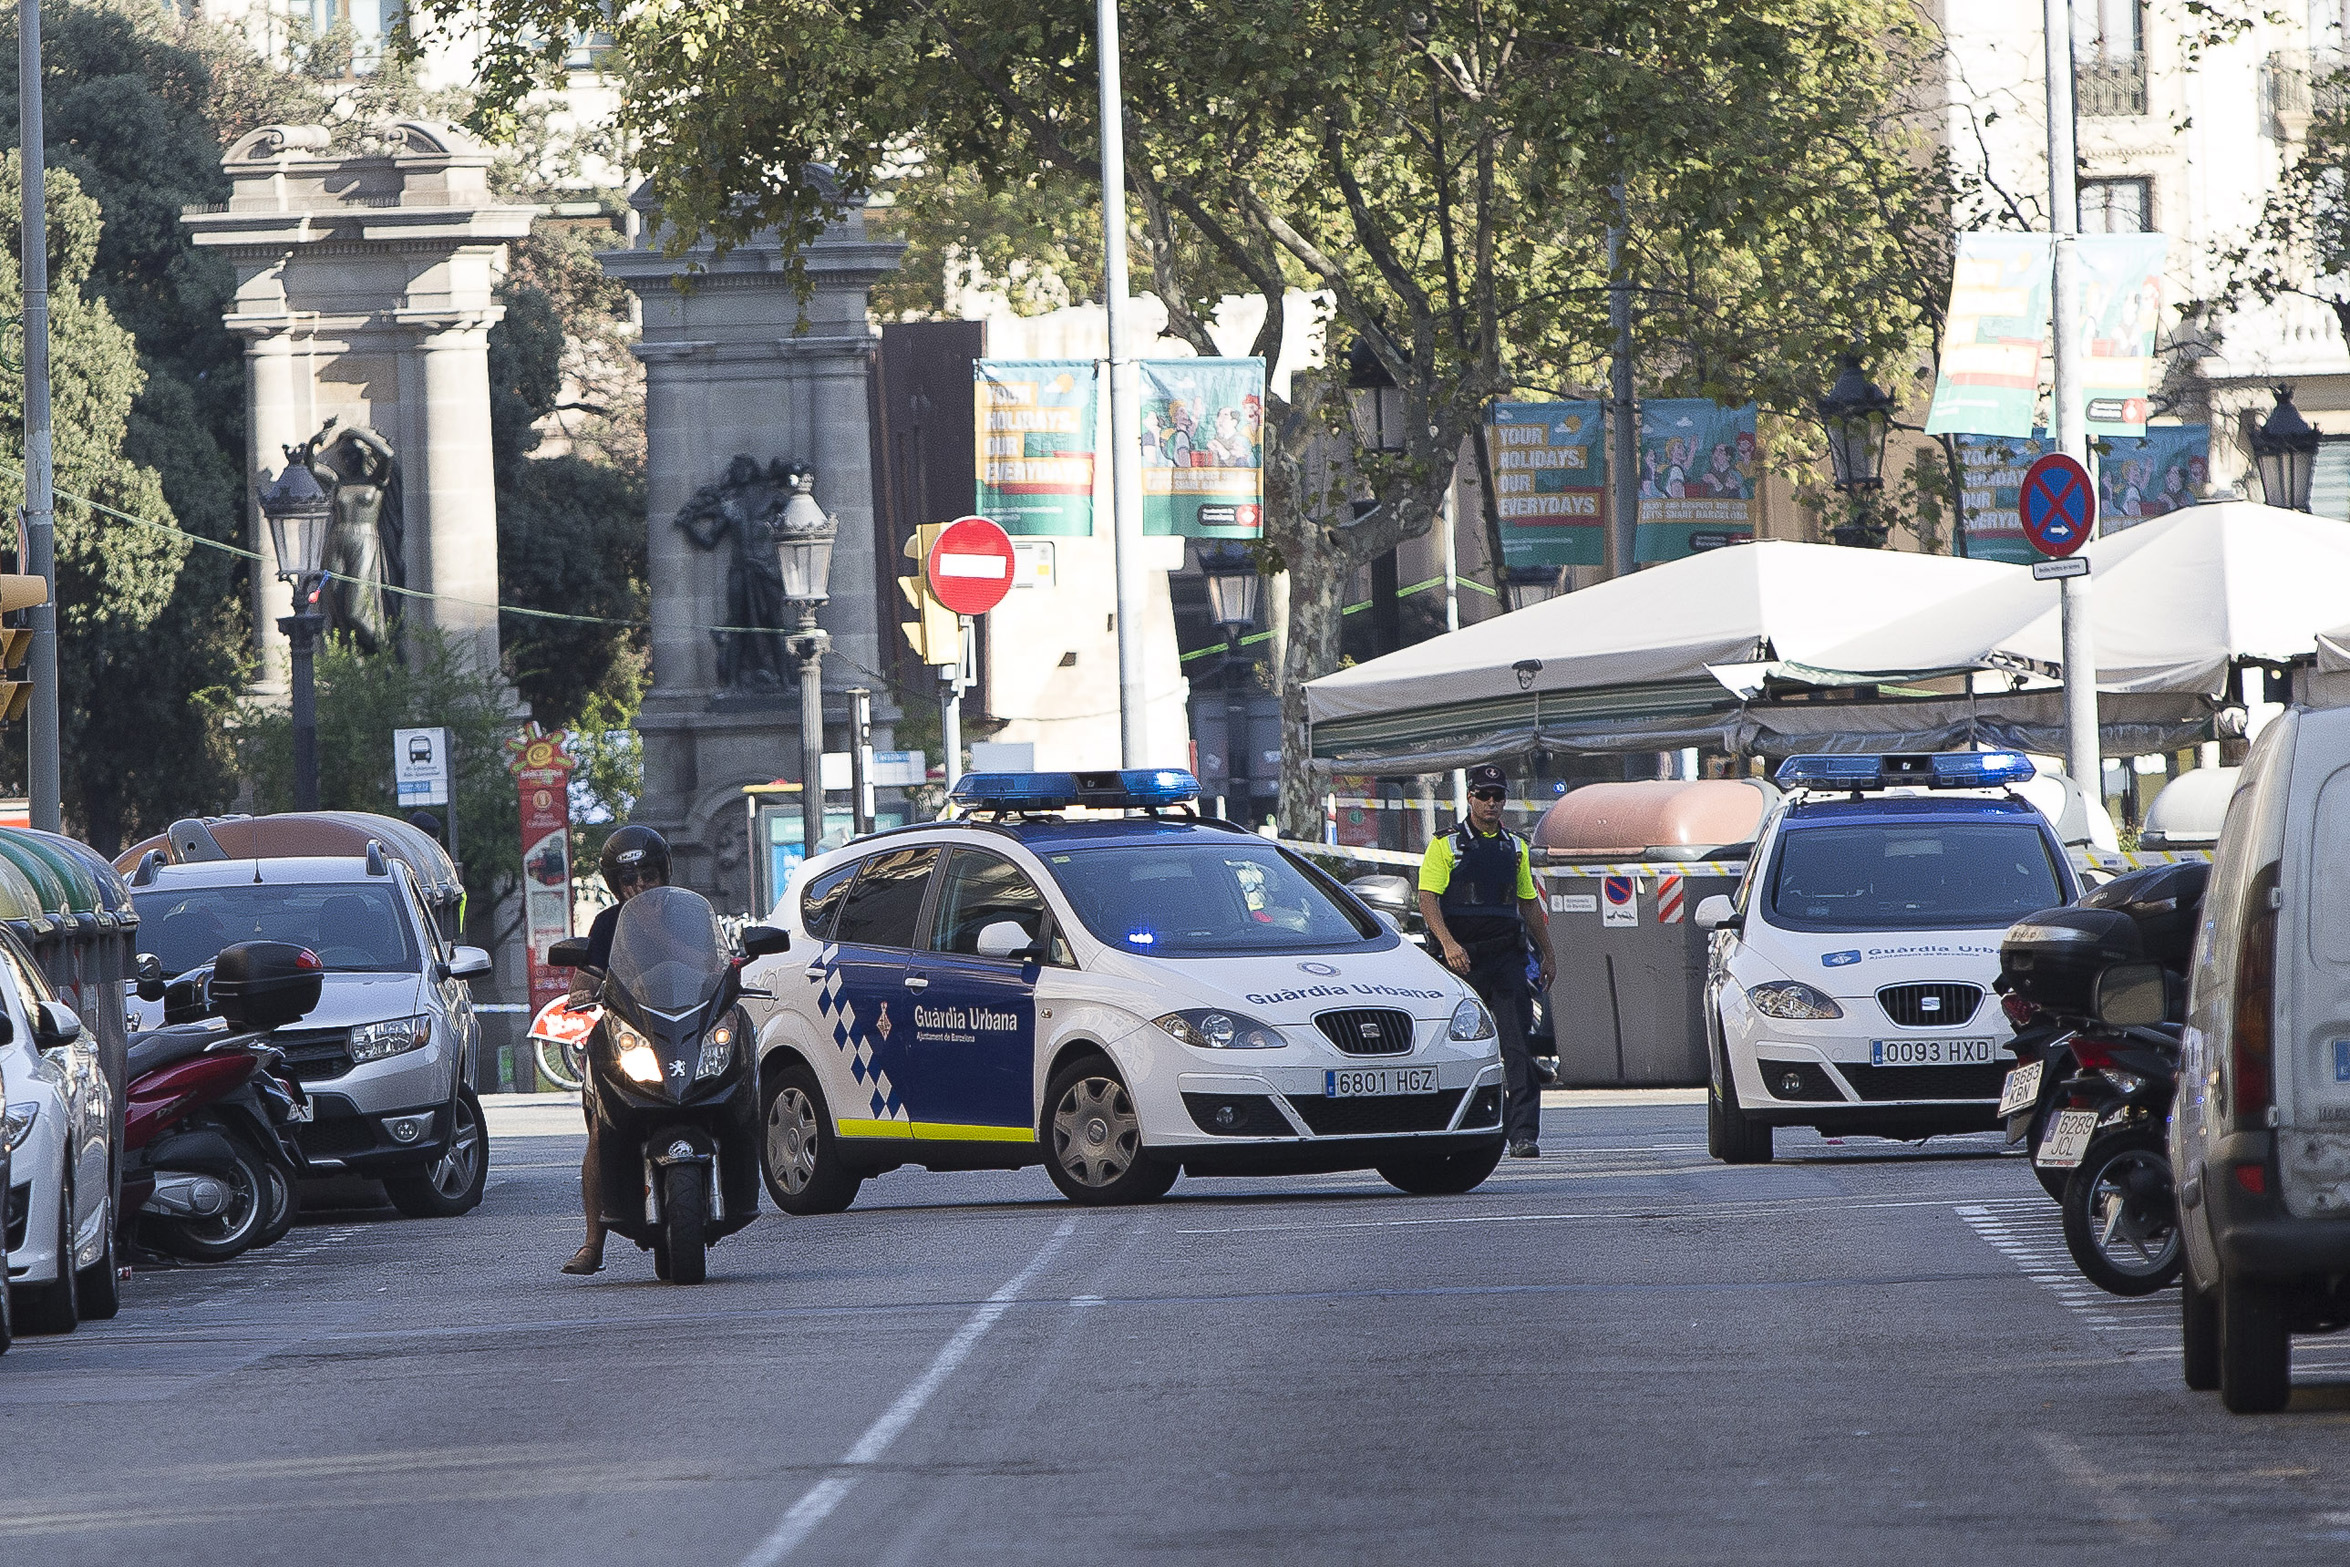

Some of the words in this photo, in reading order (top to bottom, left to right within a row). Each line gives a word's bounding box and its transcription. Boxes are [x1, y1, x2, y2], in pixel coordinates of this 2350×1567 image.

[1499, 428, 1543, 446] YOUR
[1499, 449, 1585, 469] HOLIDAYS,
[1499, 474, 1531, 494] OUR
[1499, 496, 1595, 517] EVERYDAYS
[1868, 946, 1950, 956] Guàrdia
[1246, 985, 1349, 1005] Guàrdia
[1351, 984, 1444, 999] Urbana
[915, 1005, 966, 1029] Guàrdia
[970, 1007, 1018, 1031] Urbana
[1887, 1042, 1941, 1063] 0093
[1949, 1041, 1989, 1062] HXD
[1340, 1071, 1387, 1094] 6801
[1397, 1069, 1434, 1091] HGZ
[2009, 1084, 2032, 1106] KBN
[2060, 1116, 2095, 1135] 6289
[2051, 1137, 2074, 1156] JCL
